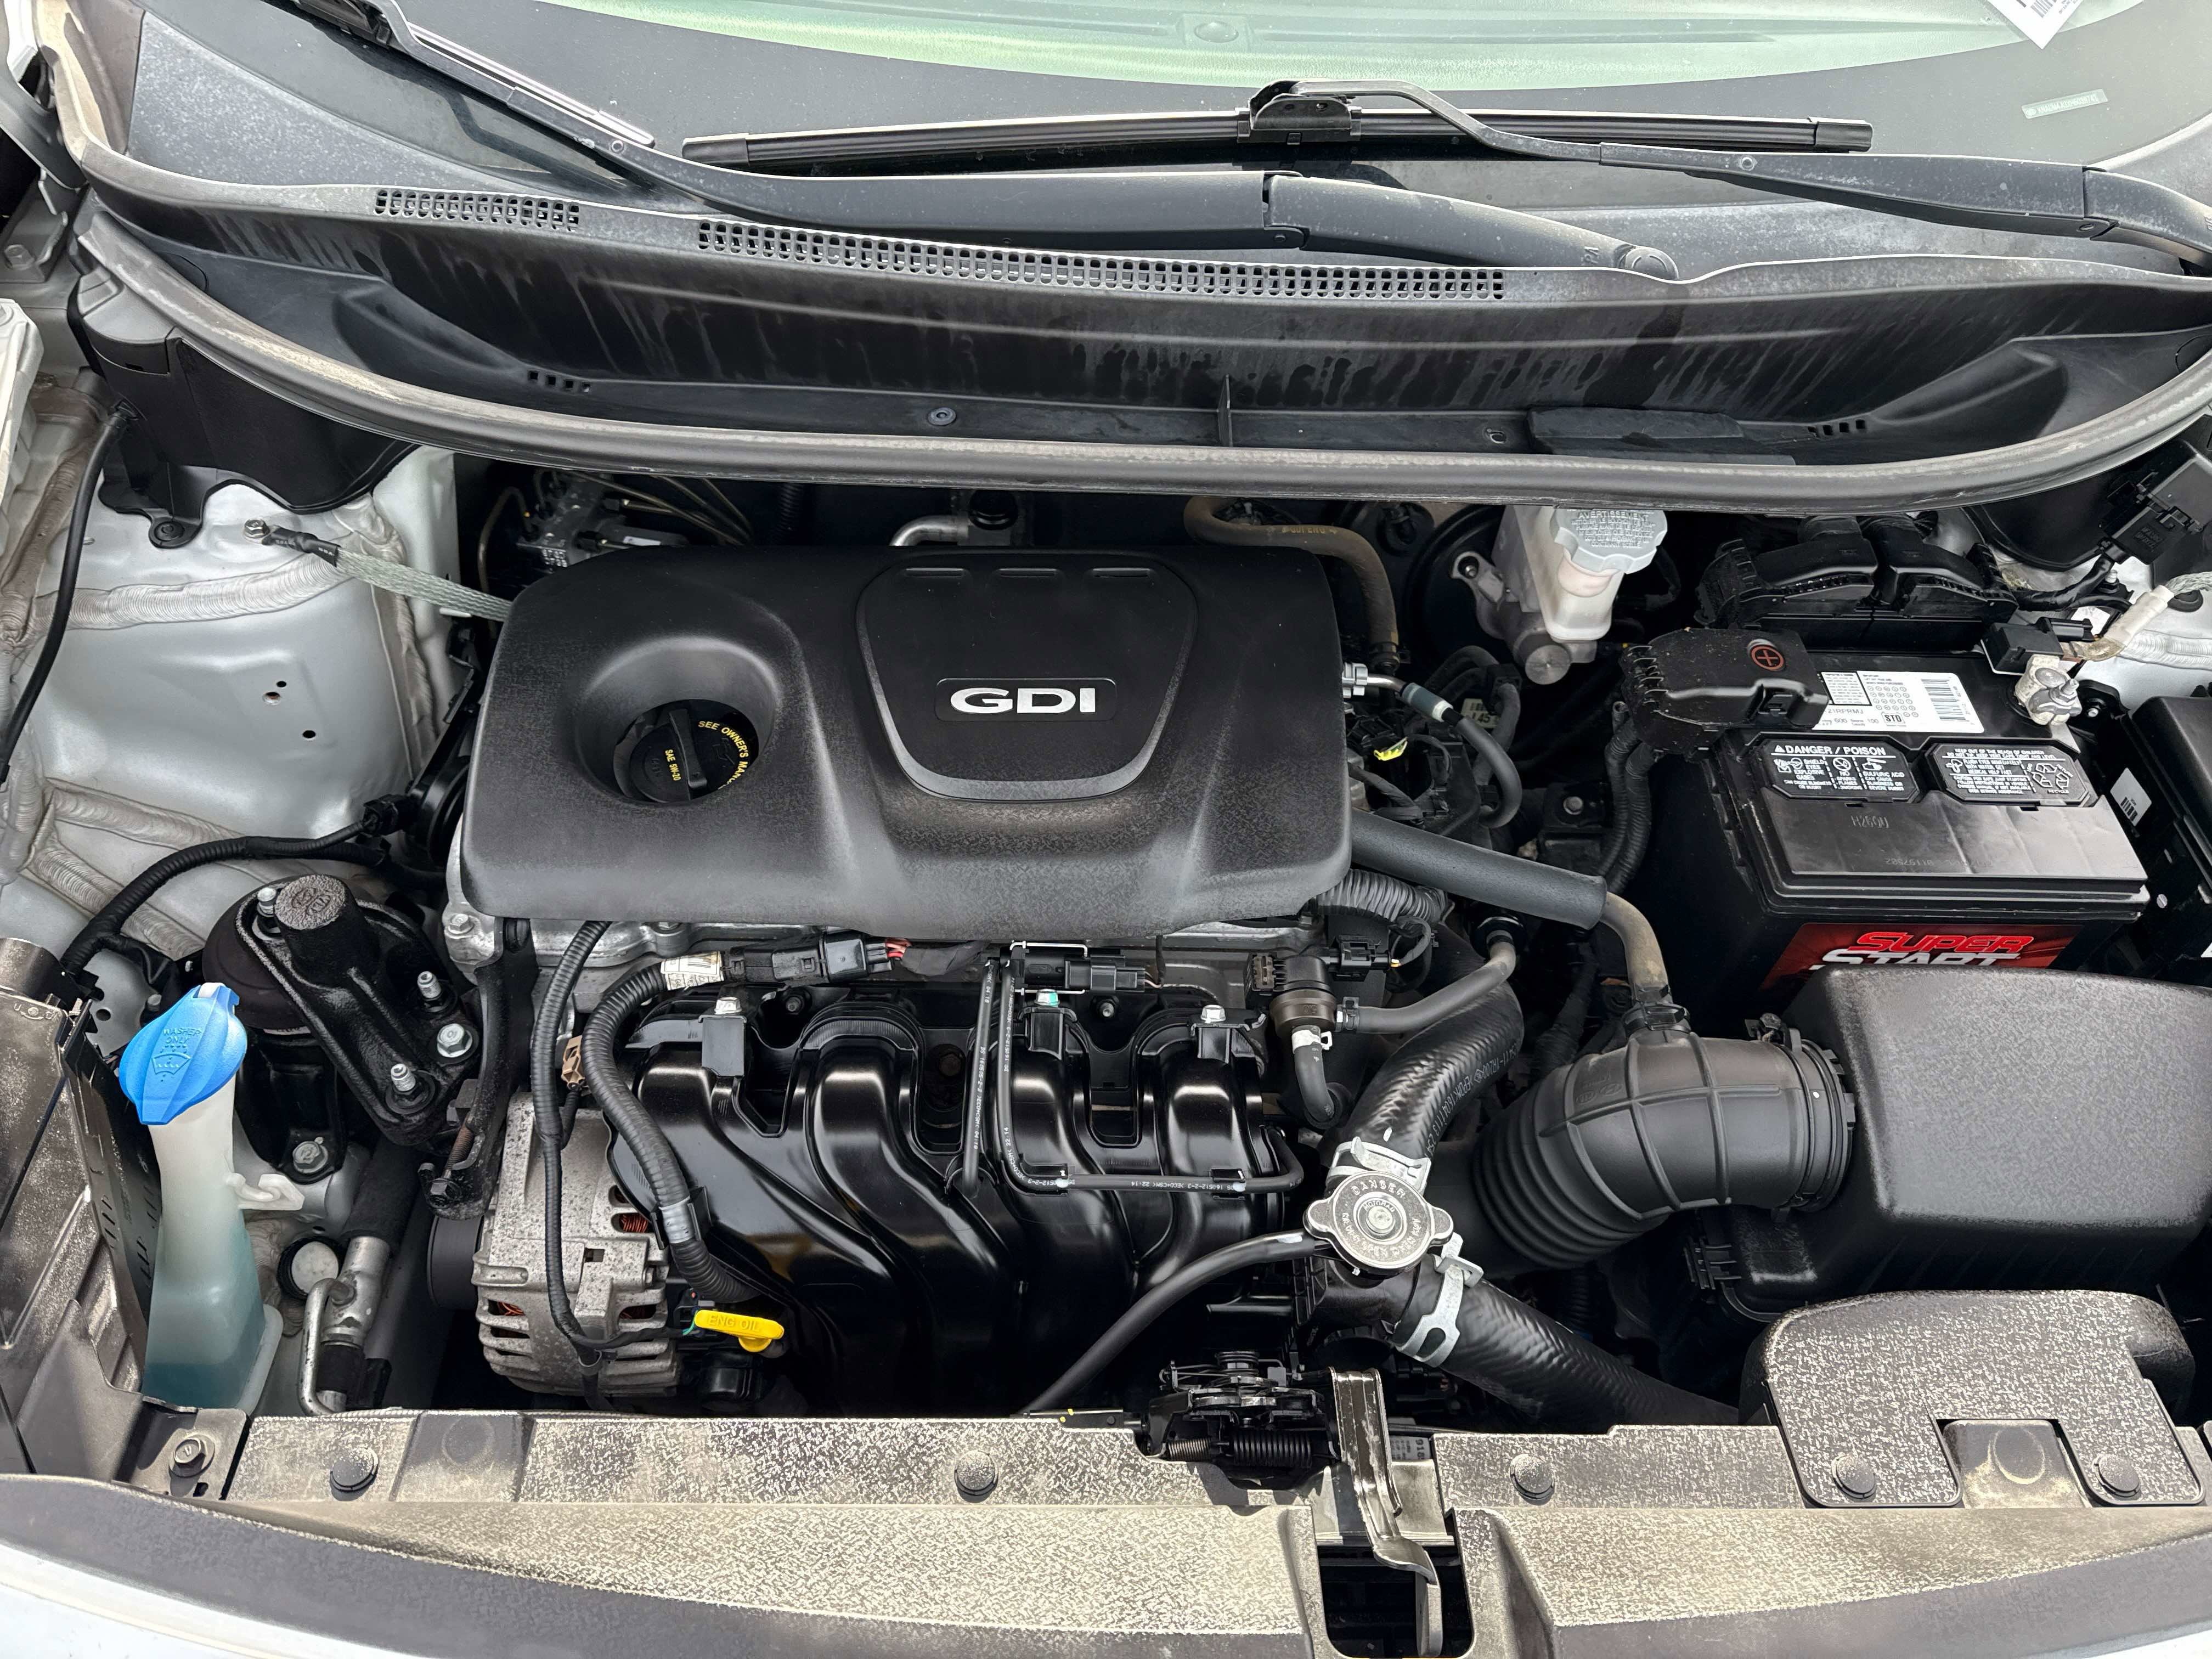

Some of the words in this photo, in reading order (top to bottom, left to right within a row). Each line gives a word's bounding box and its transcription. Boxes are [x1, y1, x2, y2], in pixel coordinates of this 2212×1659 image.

[1578, 511, 1649, 521] AVERTISSEMENT
[951, 687, 1096, 714] GDI
[698, 721, 720, 730] SEE
[721, 727, 749, 758] OWNER'S
[1785, 745, 1833, 754] DANGER
[1843, 746, 1886, 755] POISON
[665, 749, 676, 762] SAE
[669, 764, 681, 781] 5W-20
[718, 761, 748, 789] MAN
[1847, 932, 2034, 953] SUPER
[163, 1027, 202, 1036] WASHER
[166, 1035, 190, 1044] ONLY
[1351, 1179, 1406, 1199] DANGER
[708, 1314, 736, 1327] ENG
[740, 1320, 760, 1332] OIL
